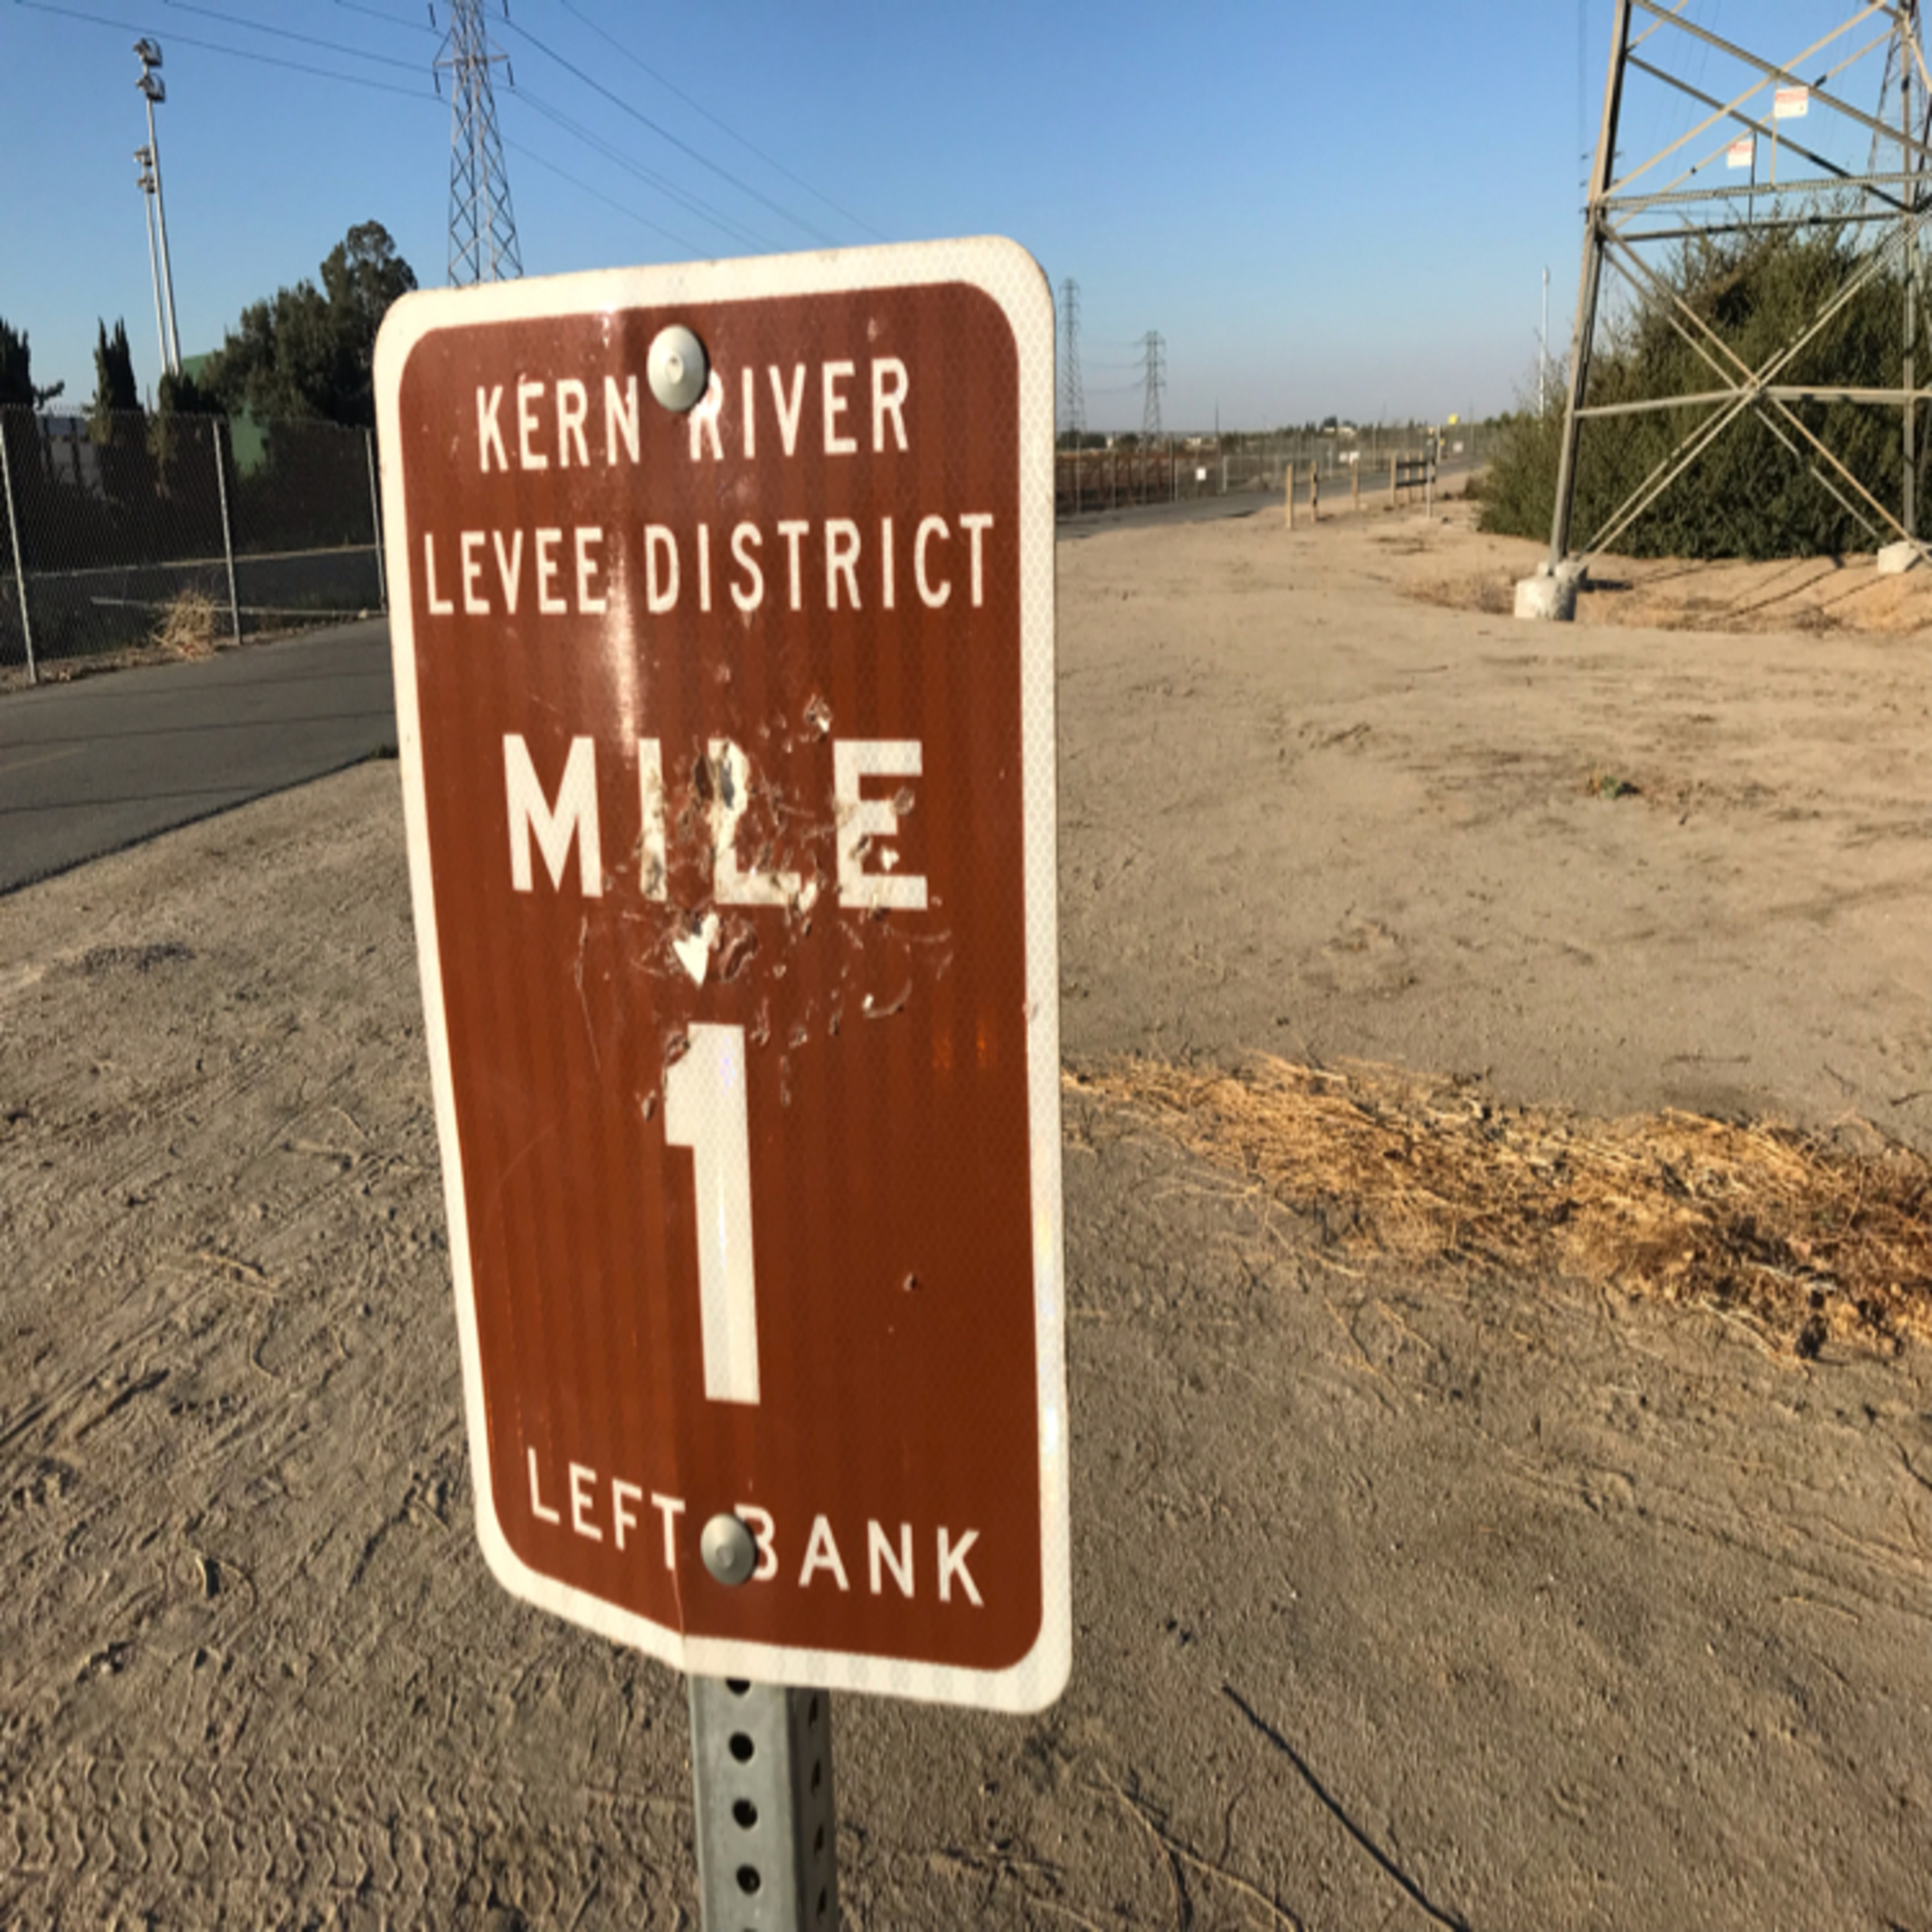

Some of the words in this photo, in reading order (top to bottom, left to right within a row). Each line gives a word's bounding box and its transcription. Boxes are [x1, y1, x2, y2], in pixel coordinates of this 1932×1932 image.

[476, 374, 641, 473] KERN
[688, 357, 909, 461] RIVER
[424, 526, 607, 615] LEVEE
[644, 513, 994, 615] DISTRICT
[502, 734, 928, 911] MILE
[663, 1022, 761, 1406] 1
[527, 1446, 686, 1571] LEFT
[734, 1502, 984, 1607] BANK
